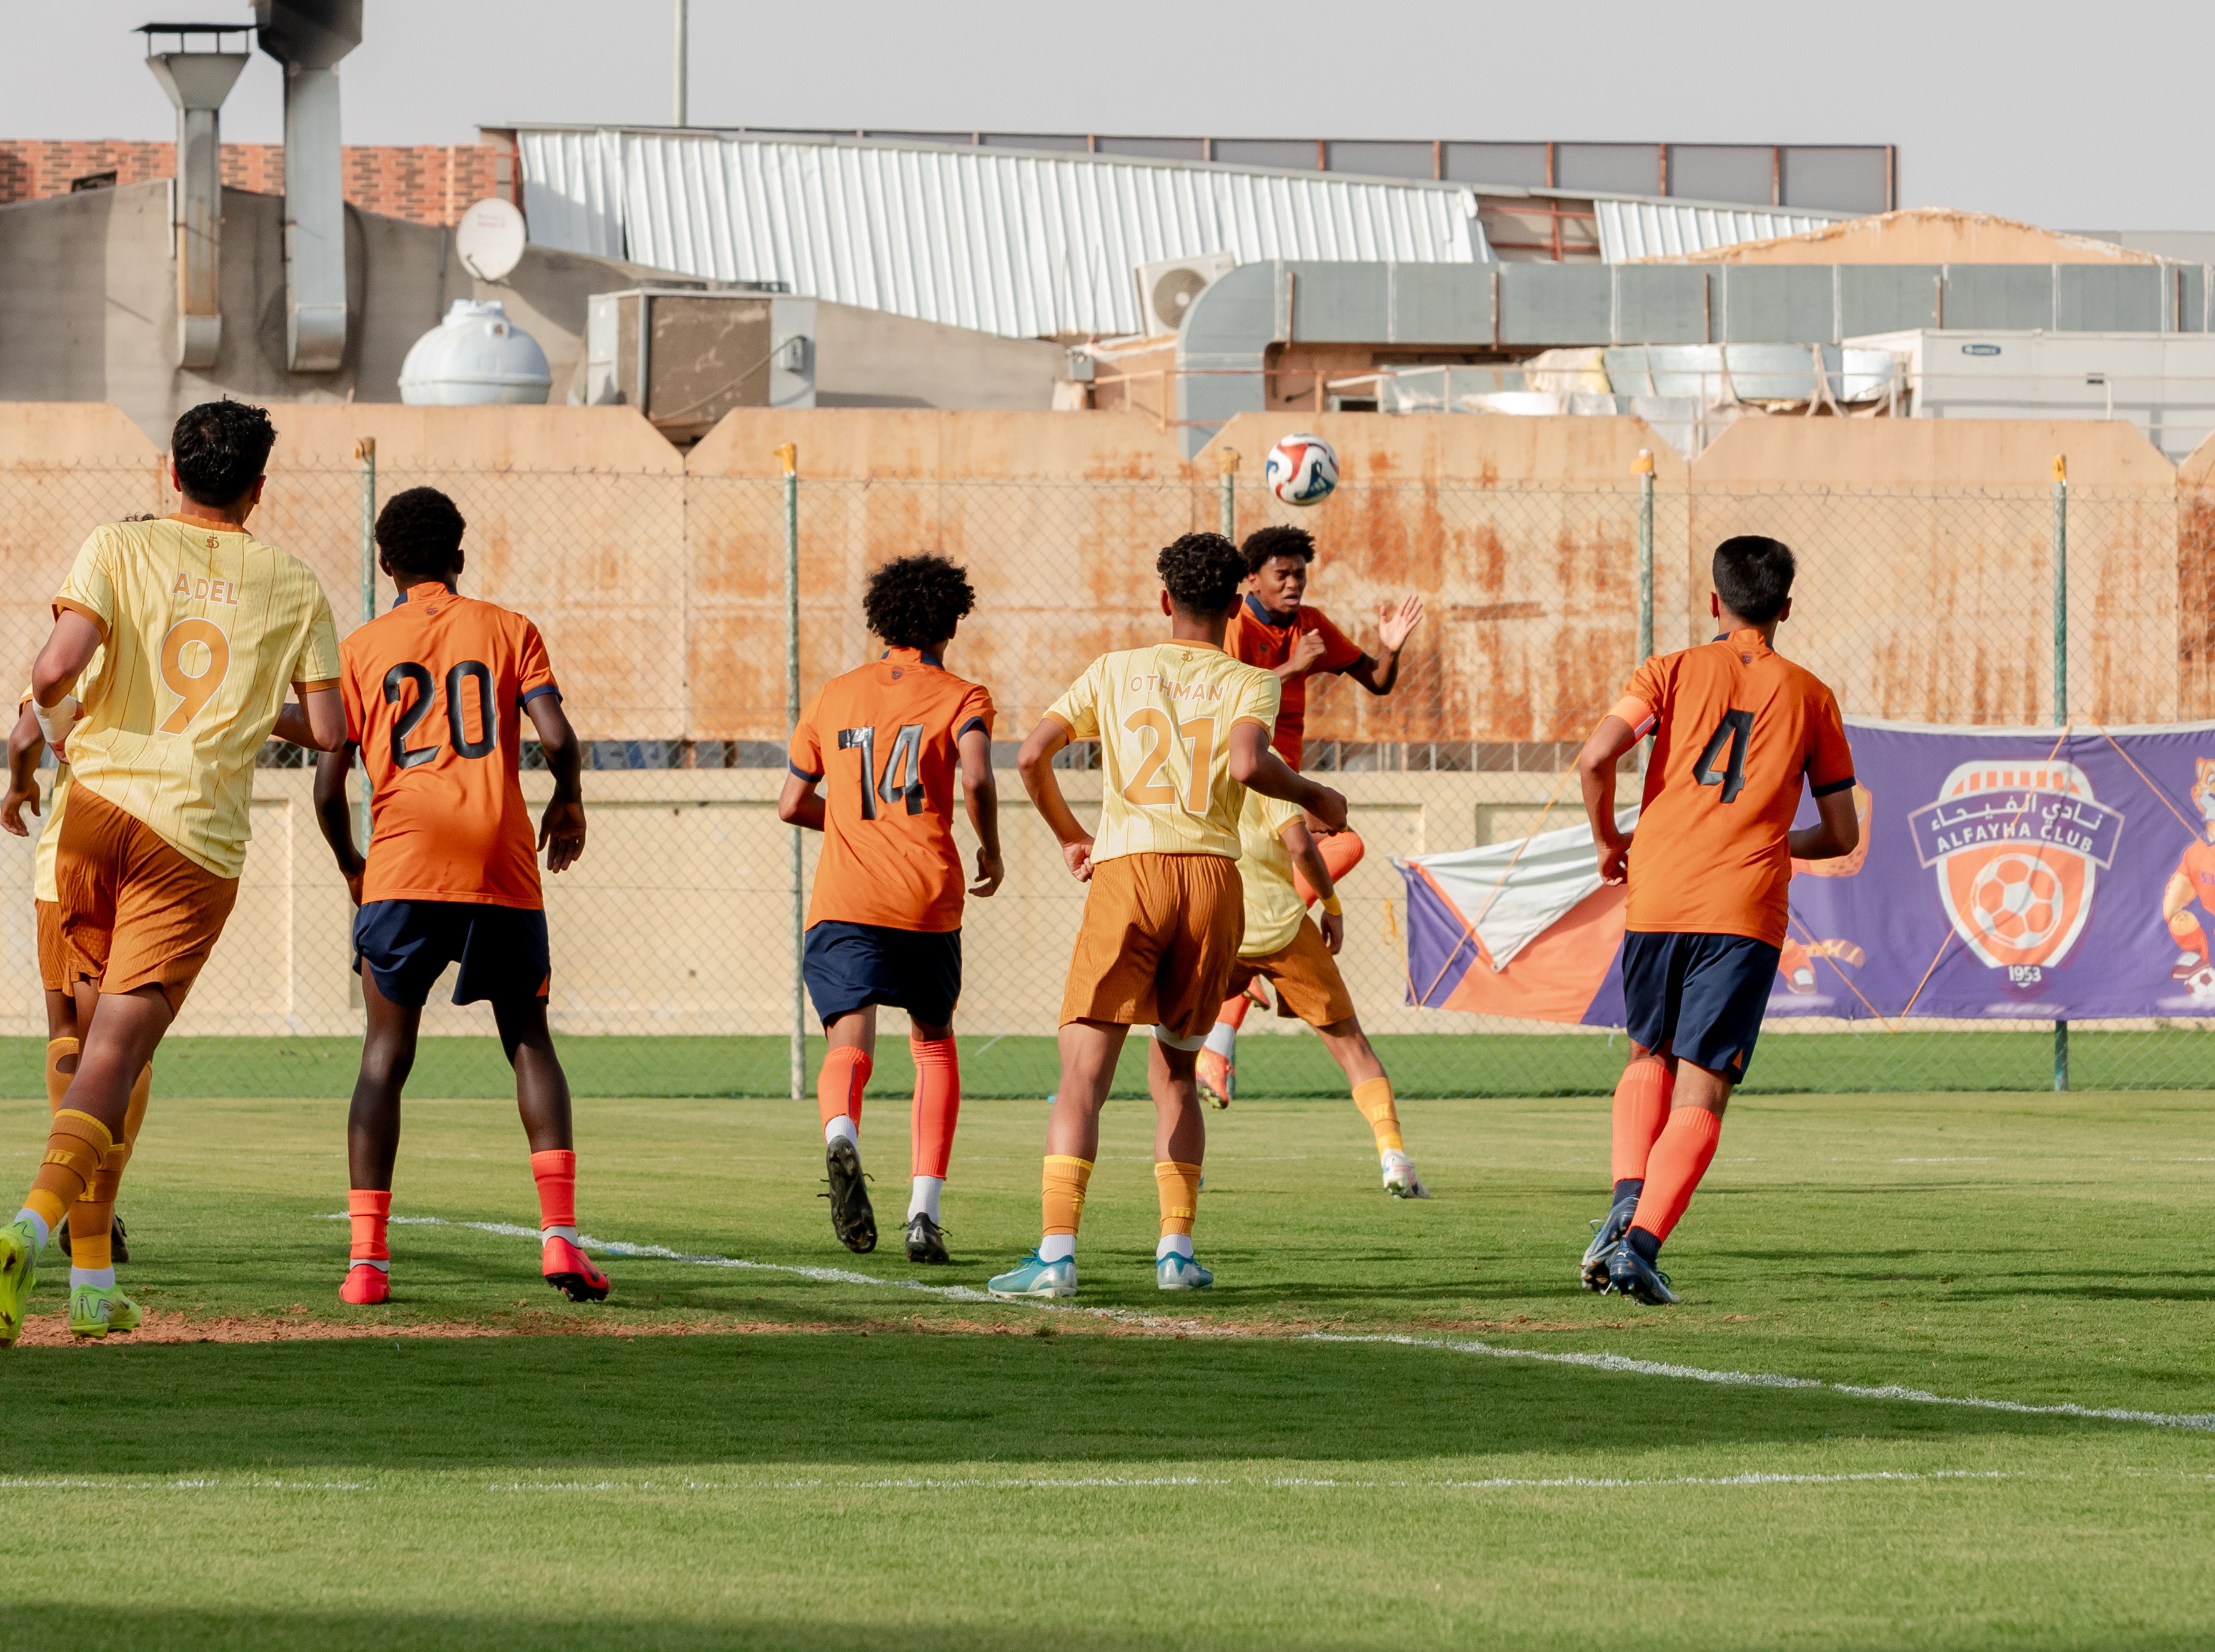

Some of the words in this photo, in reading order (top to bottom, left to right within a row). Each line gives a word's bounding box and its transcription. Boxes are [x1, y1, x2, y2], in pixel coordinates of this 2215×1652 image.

[172, 572, 239, 606] ADEL
[156, 617, 231, 737] 9
[383, 660, 498, 770] 20
[1130, 674, 1224, 702] OTHMAN
[837, 724, 925, 820] 14
[1122, 705, 1217, 814] 21
[1692, 708, 1756, 804] 4
[1937, 822, 2031, 853] ALFAYHA
[2039, 824, 2093, 852] CLUB
[2008, 965, 2042, 982] 1953
